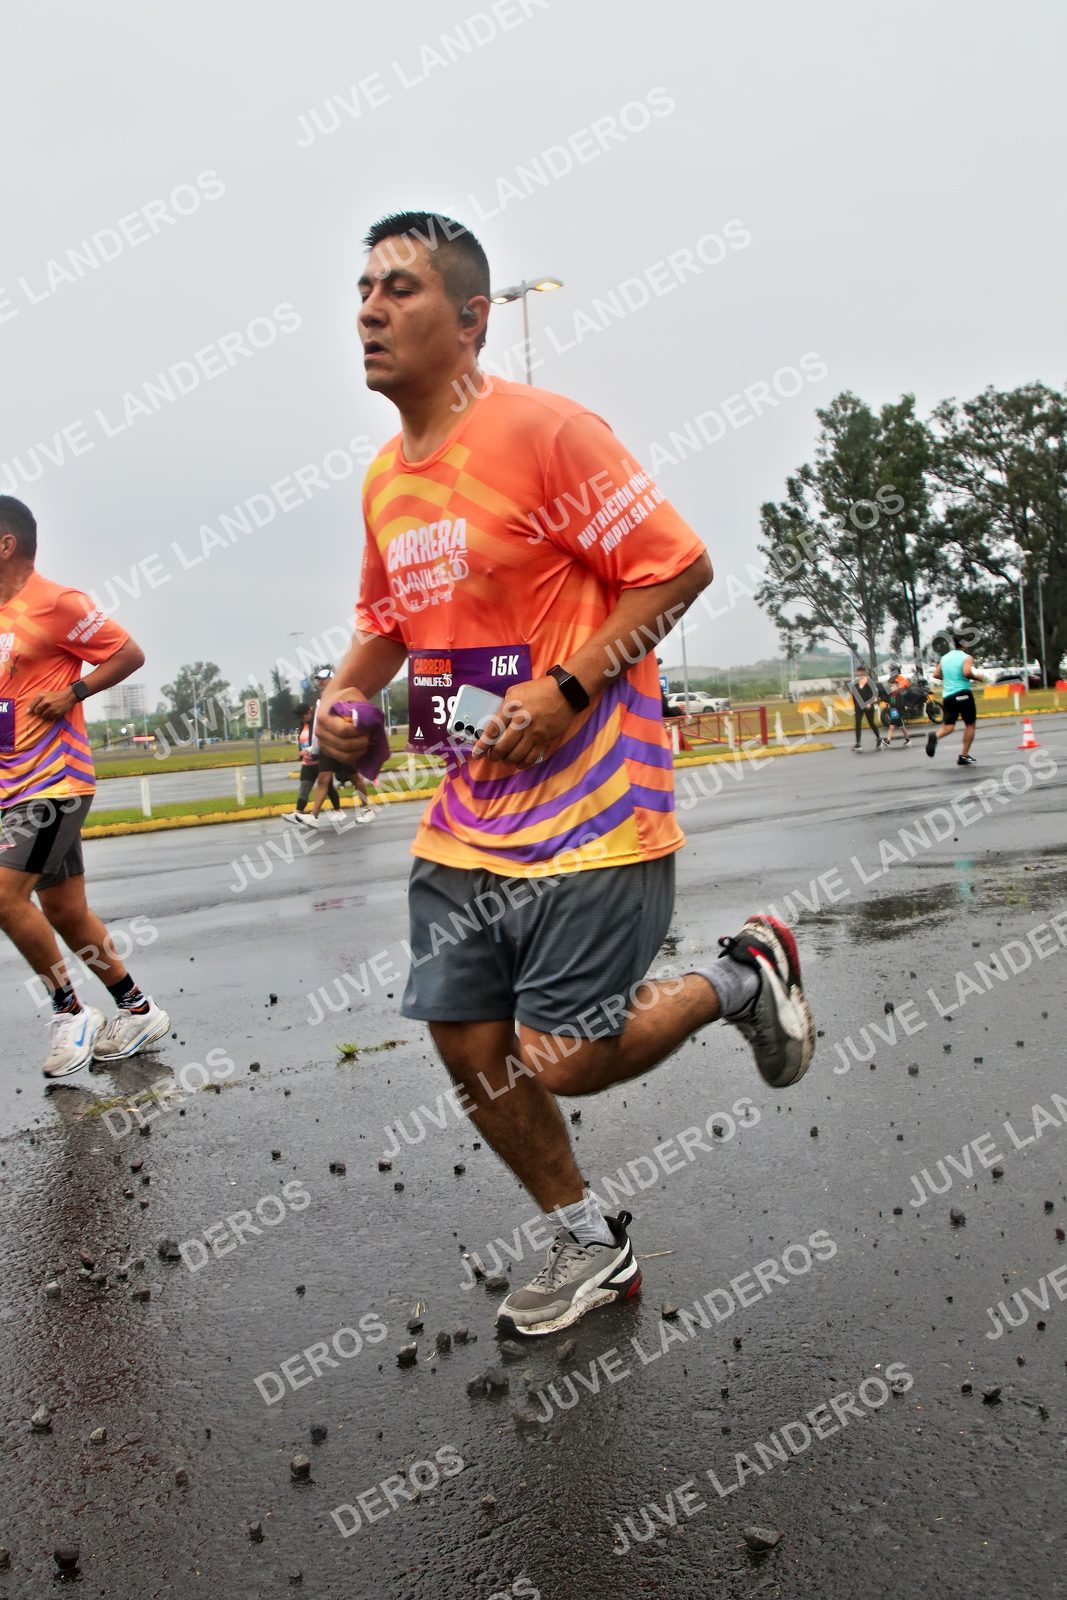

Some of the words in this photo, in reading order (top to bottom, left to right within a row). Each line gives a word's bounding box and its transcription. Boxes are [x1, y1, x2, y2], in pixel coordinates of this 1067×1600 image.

[387, 517, 467, 573] CARRERA
[577, 485, 635, 550] NUTRICIÓN
[599, 501, 649, 556] IMPULSA
[491, 655, 519, 677] 15K
